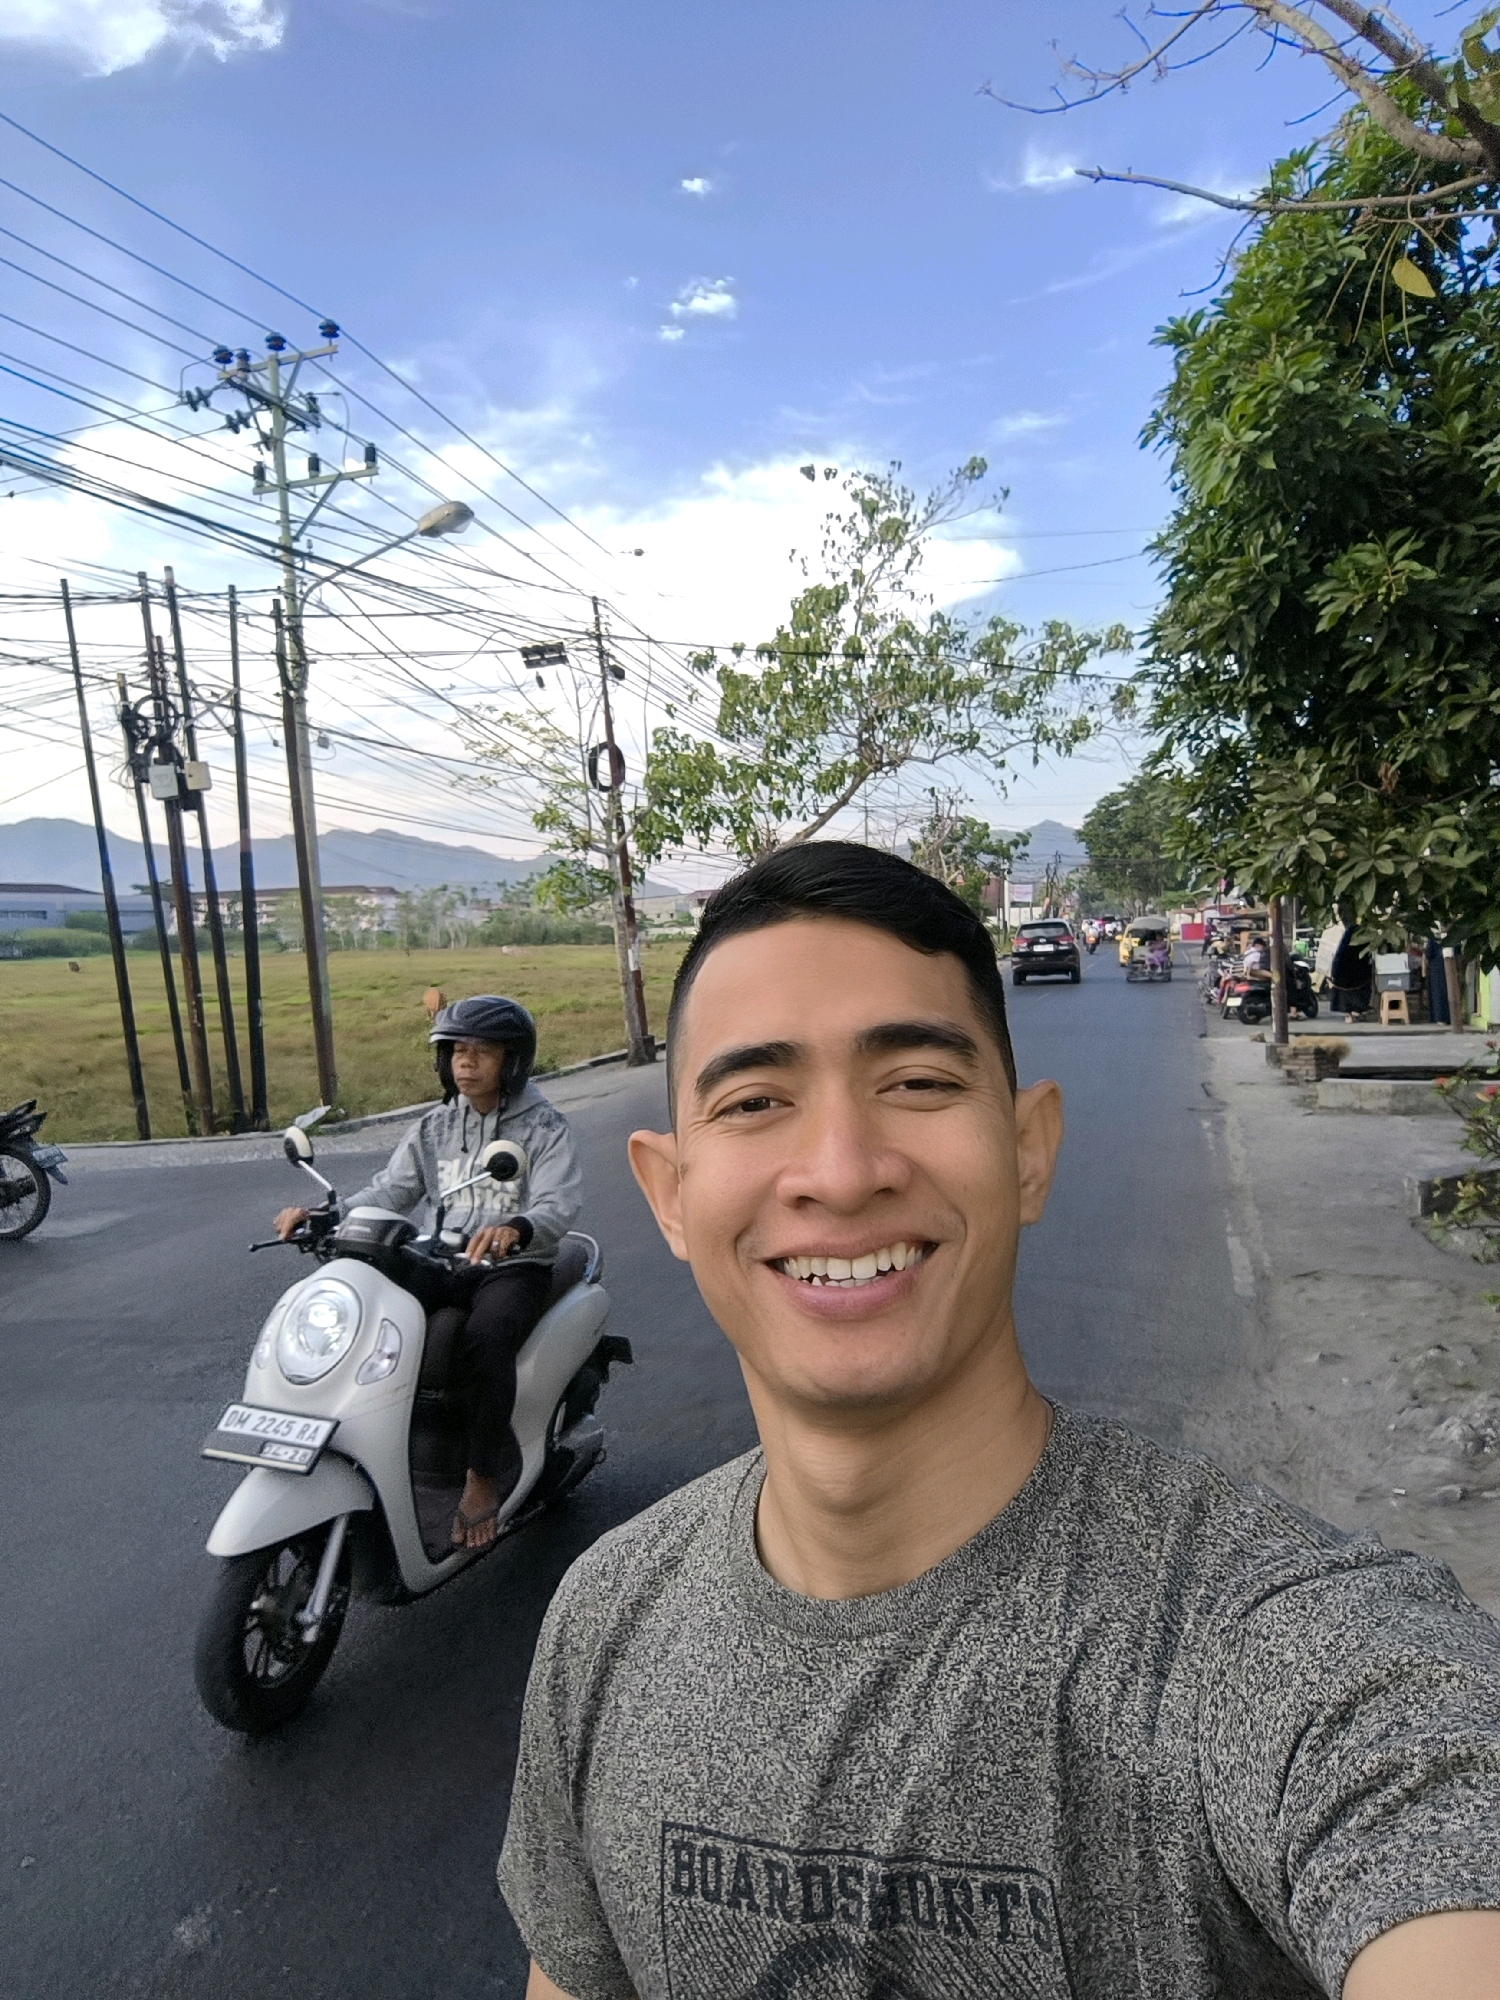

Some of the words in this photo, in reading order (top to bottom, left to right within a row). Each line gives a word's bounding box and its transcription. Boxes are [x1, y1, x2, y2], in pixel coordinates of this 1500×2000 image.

[225, 1410, 250, 1429] DM
[252, 1416, 296, 1437] 2245
[297, 1423, 320, 1442] RA
